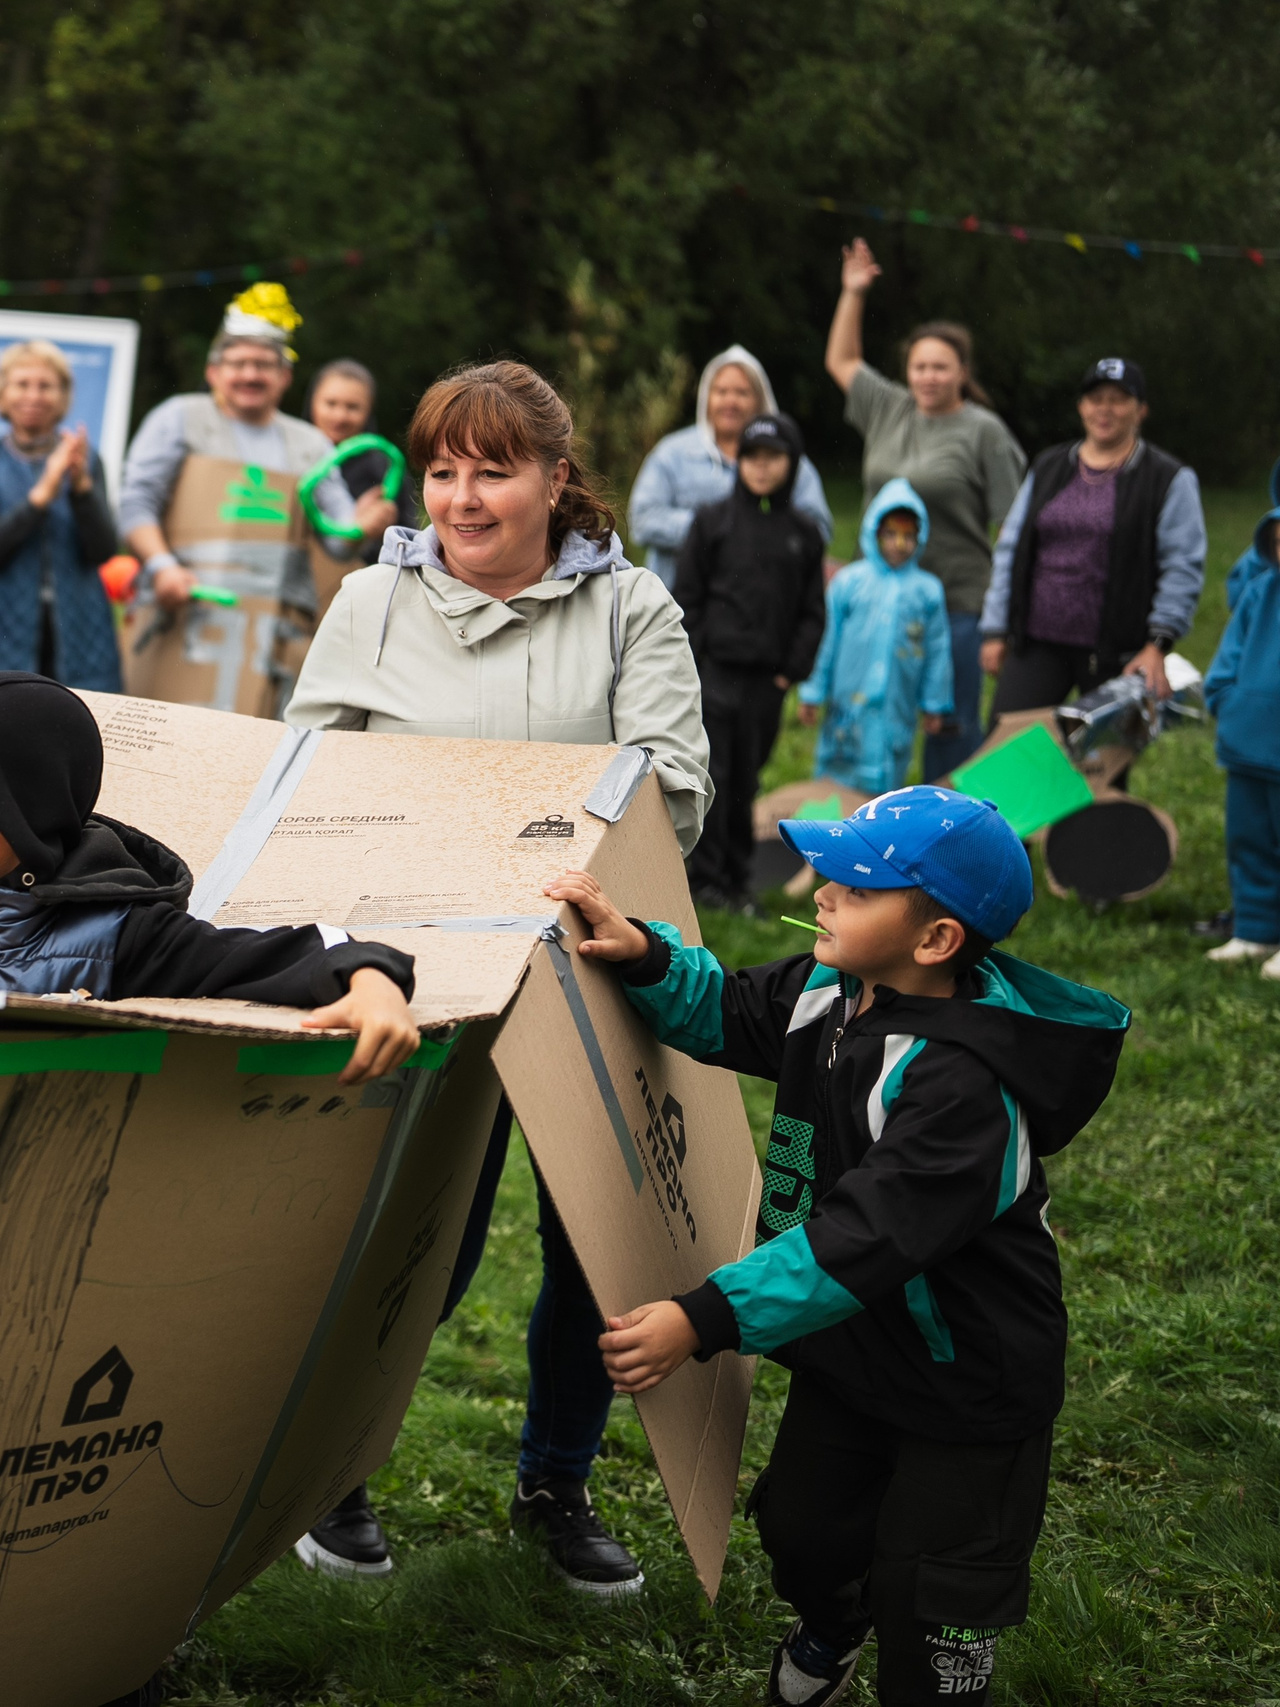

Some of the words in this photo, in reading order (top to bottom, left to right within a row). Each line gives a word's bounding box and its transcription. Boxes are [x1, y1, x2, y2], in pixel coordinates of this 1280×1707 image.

[115, 711, 168, 724] БАЛКОН
[125, 700, 168, 711] ГАРАЖ
[104, 723, 158, 737] ВАННАЯ
[329, 813, 406, 824] СРЕДНИЙ
[634, 1065, 697, 1245] ЛЕМАНА
[645, 1123, 678, 1214] ПРО
[633, 1130, 679, 1252] lemanapro.ru
[25, 1464, 110, 1508] ПРО
[0, 1508, 110, 1546] lemanapro.ru
[925, 1634, 957, 1649] FASHI
